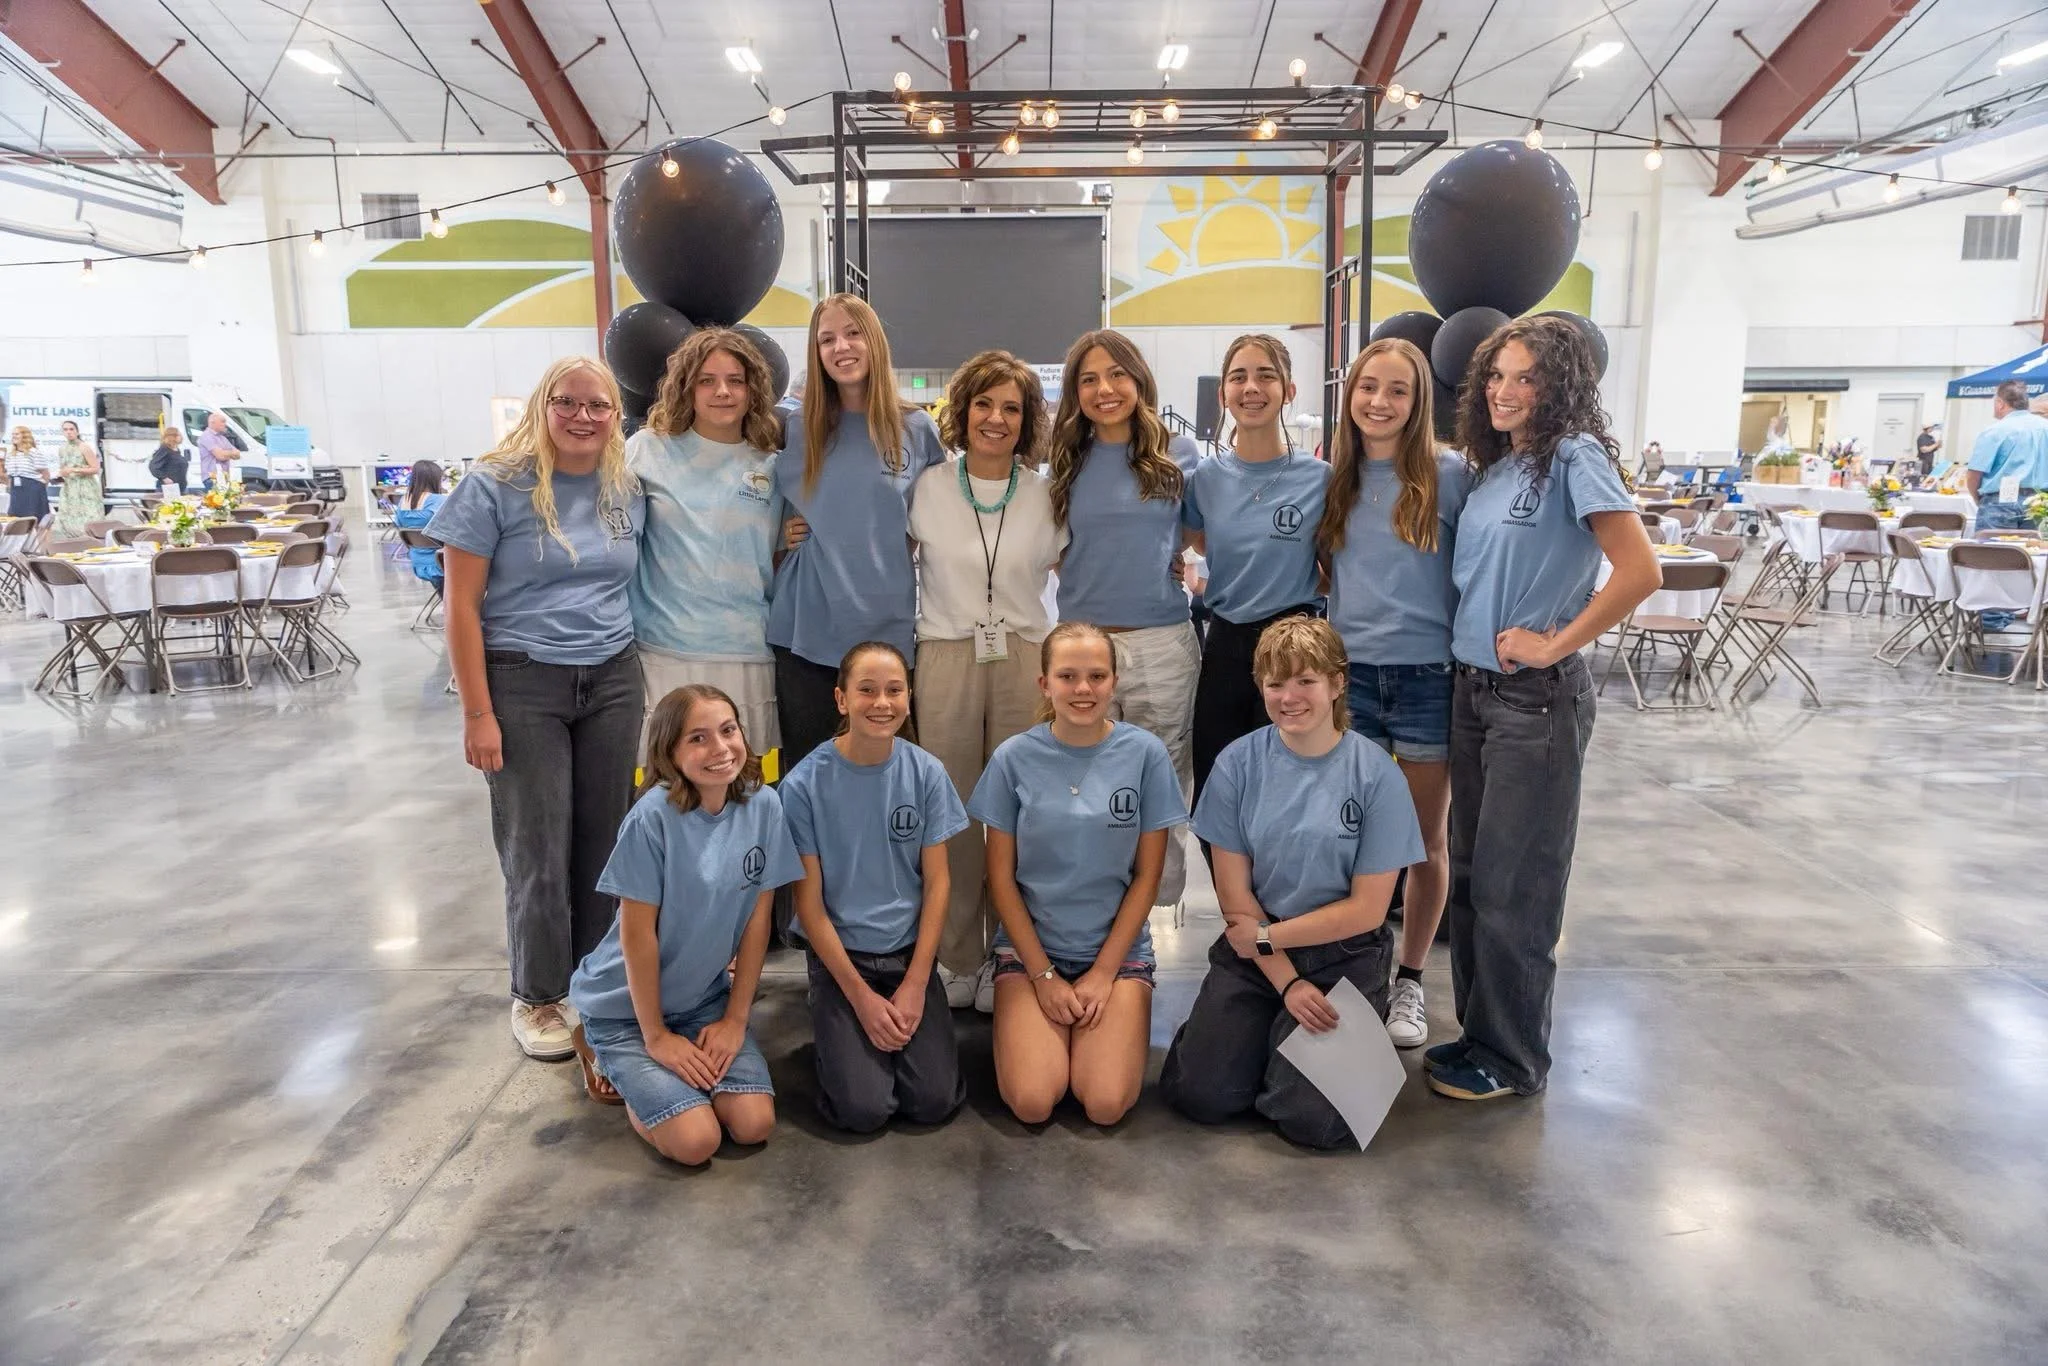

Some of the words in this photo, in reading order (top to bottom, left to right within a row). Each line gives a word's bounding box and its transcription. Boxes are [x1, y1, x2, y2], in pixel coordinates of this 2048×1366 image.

[1052, 373, 1061, 381] Fo
[12, 406, 48, 417] LITTLE
[52, 406, 91, 418] LAMBS
[738, 490, 755, 500] Little
[1500, 519, 1537, 528] AMBASSADOR
[1269, 534, 1302, 542] AMBASSADOR
